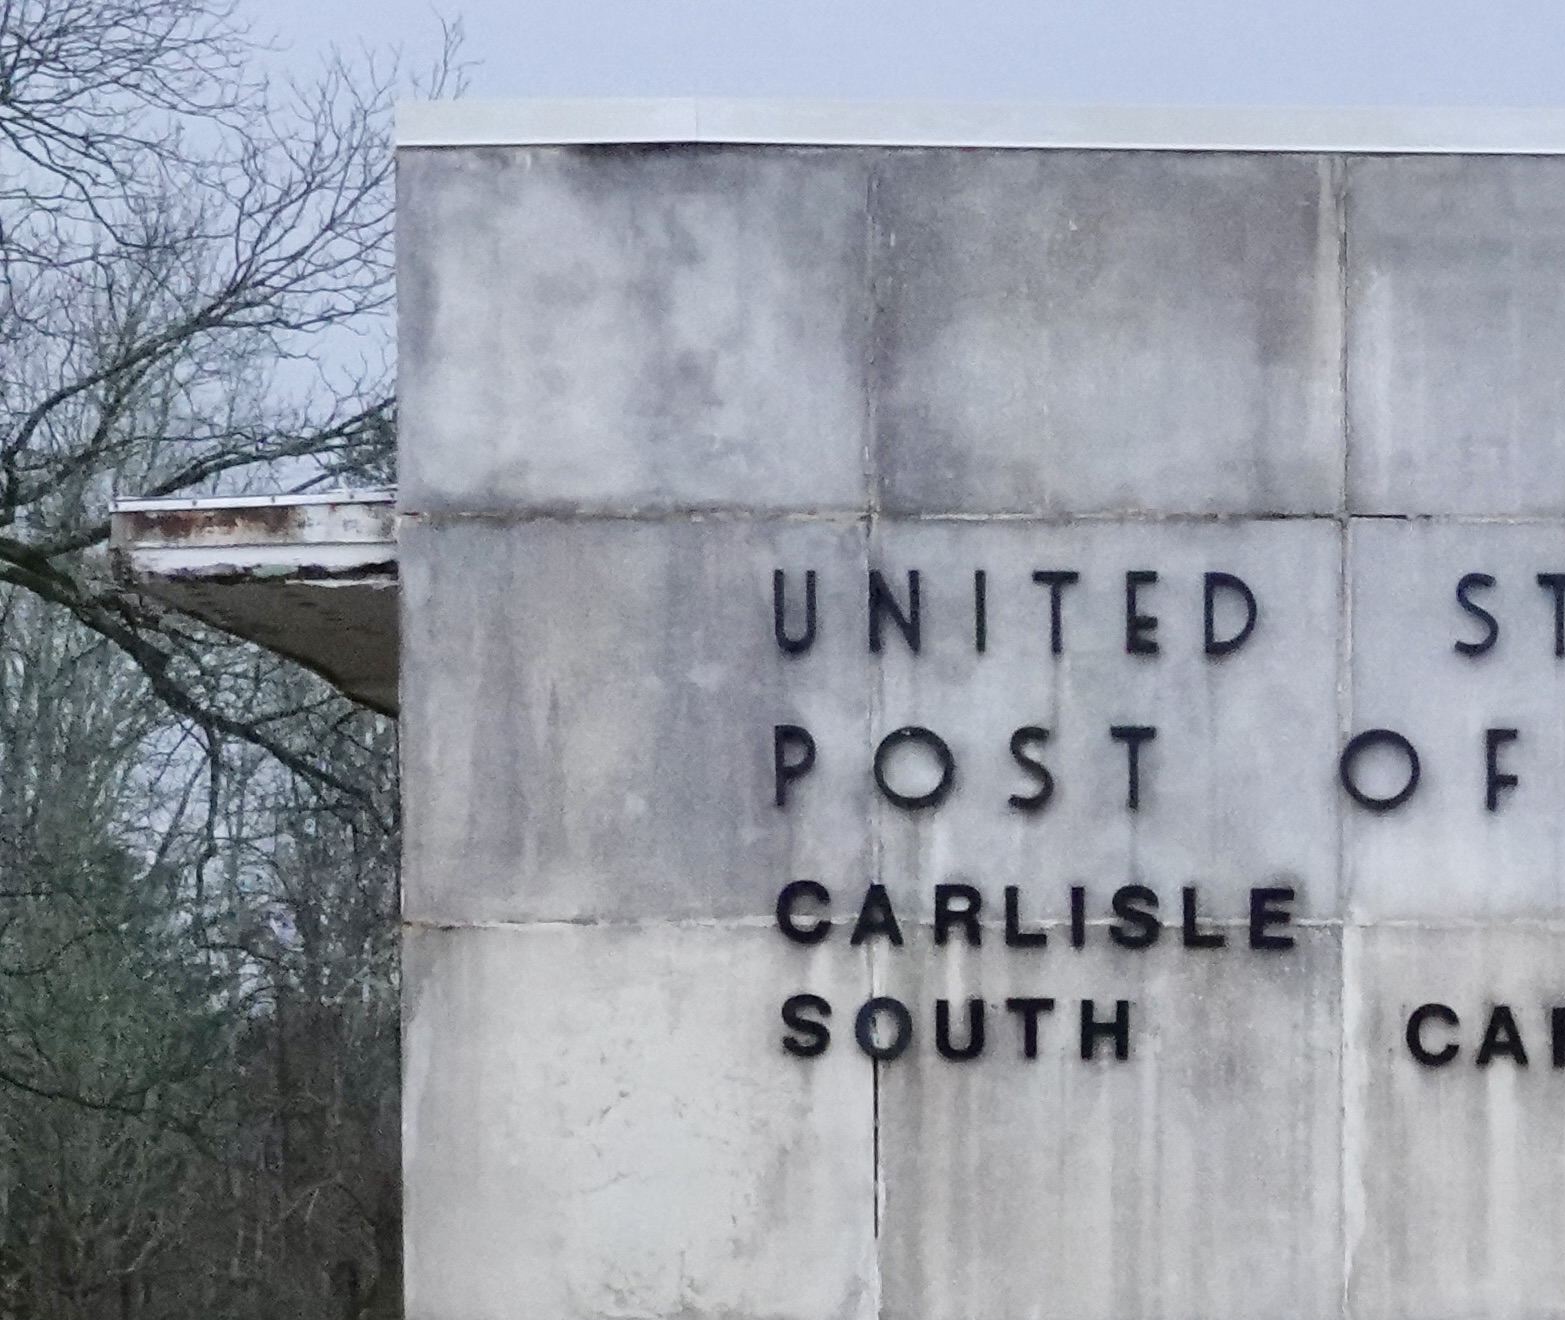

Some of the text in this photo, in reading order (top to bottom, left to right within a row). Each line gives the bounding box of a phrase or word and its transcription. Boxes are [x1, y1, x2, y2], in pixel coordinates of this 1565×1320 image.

[773, 569, 1258, 658] UNITED
[773, 724, 1158, 809] POST
[774, 879, 1297, 950] CARLISLE
[781, 994, 1133, 1063] SOUTH
